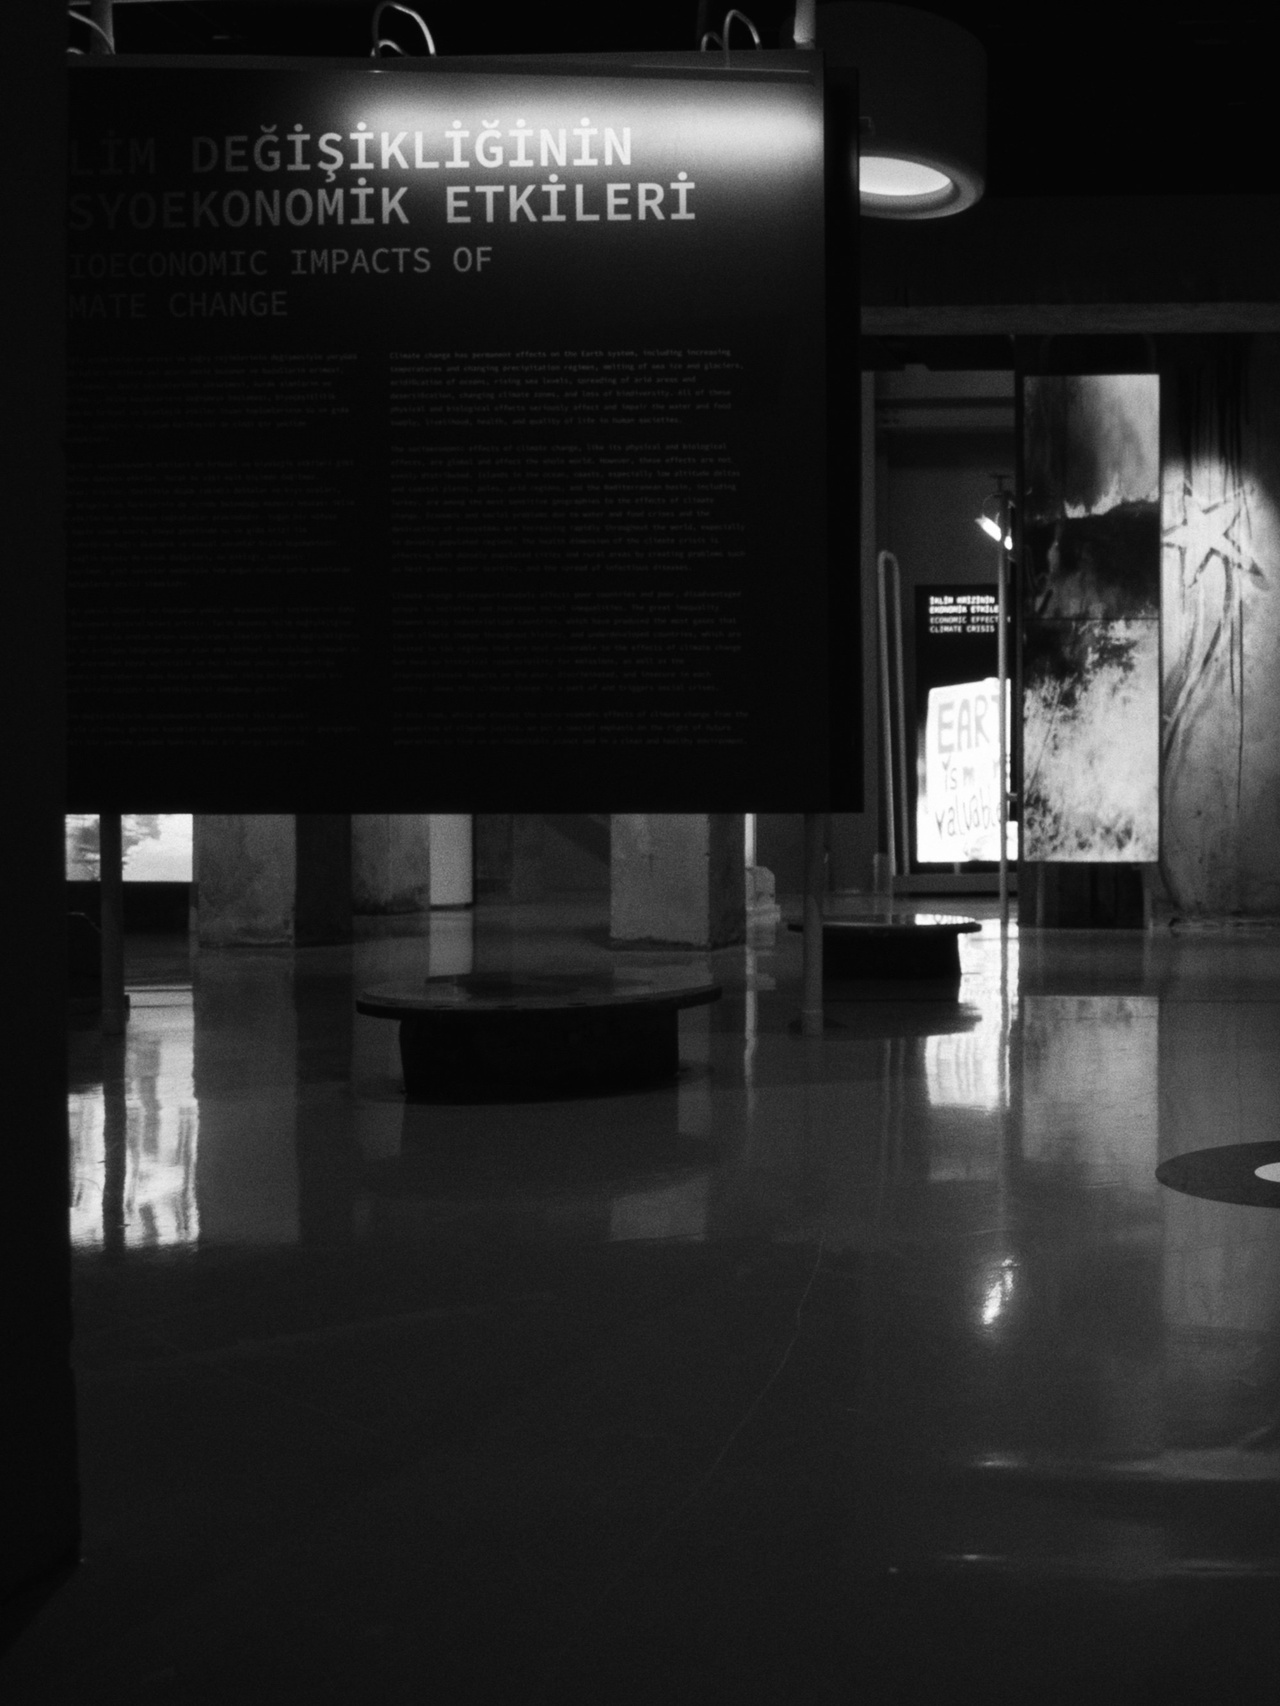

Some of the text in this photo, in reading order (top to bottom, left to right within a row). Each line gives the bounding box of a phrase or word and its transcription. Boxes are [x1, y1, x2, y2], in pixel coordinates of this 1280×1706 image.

[191, 117, 631, 182] DEĞİŞİKLİĞİNİN
[70, 171, 696, 231] SYOEKONOMİK ETKİLERİ
[70, 246, 492, 279] IOECONOMIC IMPACTS OF
[70, 290, 288, 319] MATE CHANGE
[929, 625, 996, 633] CLIMATE CRISIS
